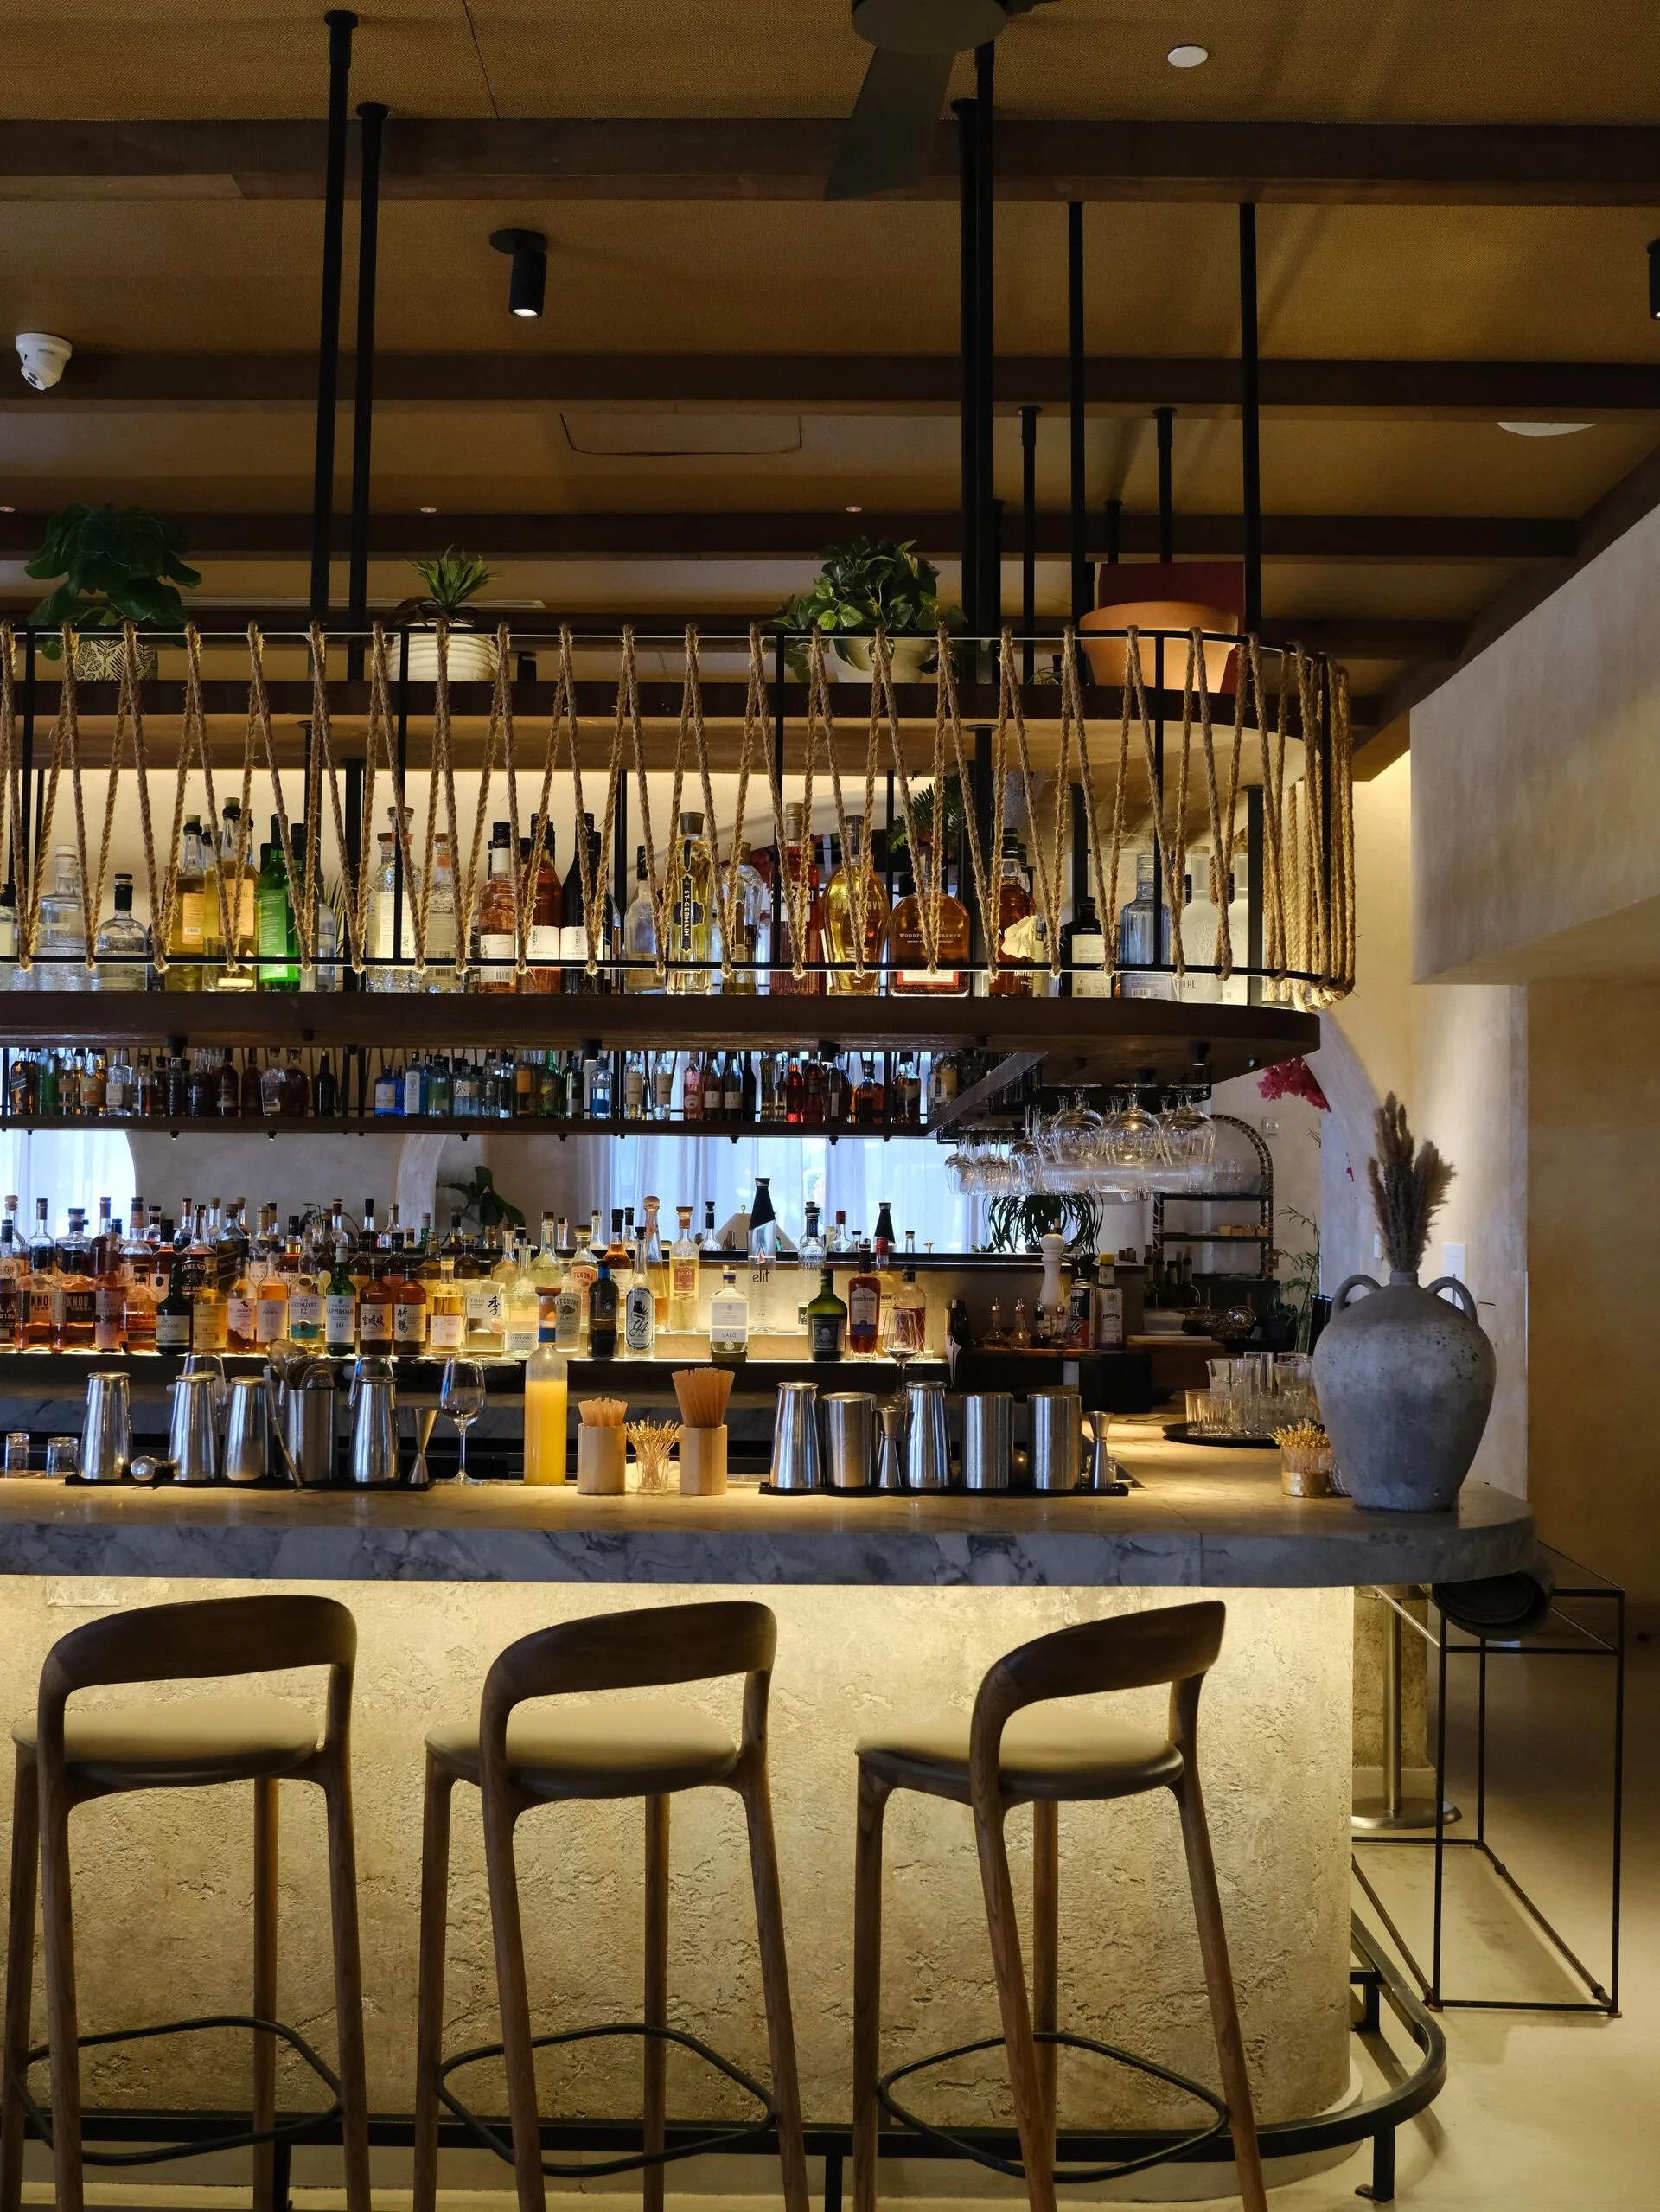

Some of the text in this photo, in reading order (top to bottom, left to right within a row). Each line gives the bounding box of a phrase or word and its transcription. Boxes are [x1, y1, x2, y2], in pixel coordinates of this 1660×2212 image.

[181, 1263, 206, 1273] JAMESO
[752, 1268, 769, 1282] elit
[31, 1295, 49, 1307] KNO
[67, 1295, 88, 1307] KNOB
